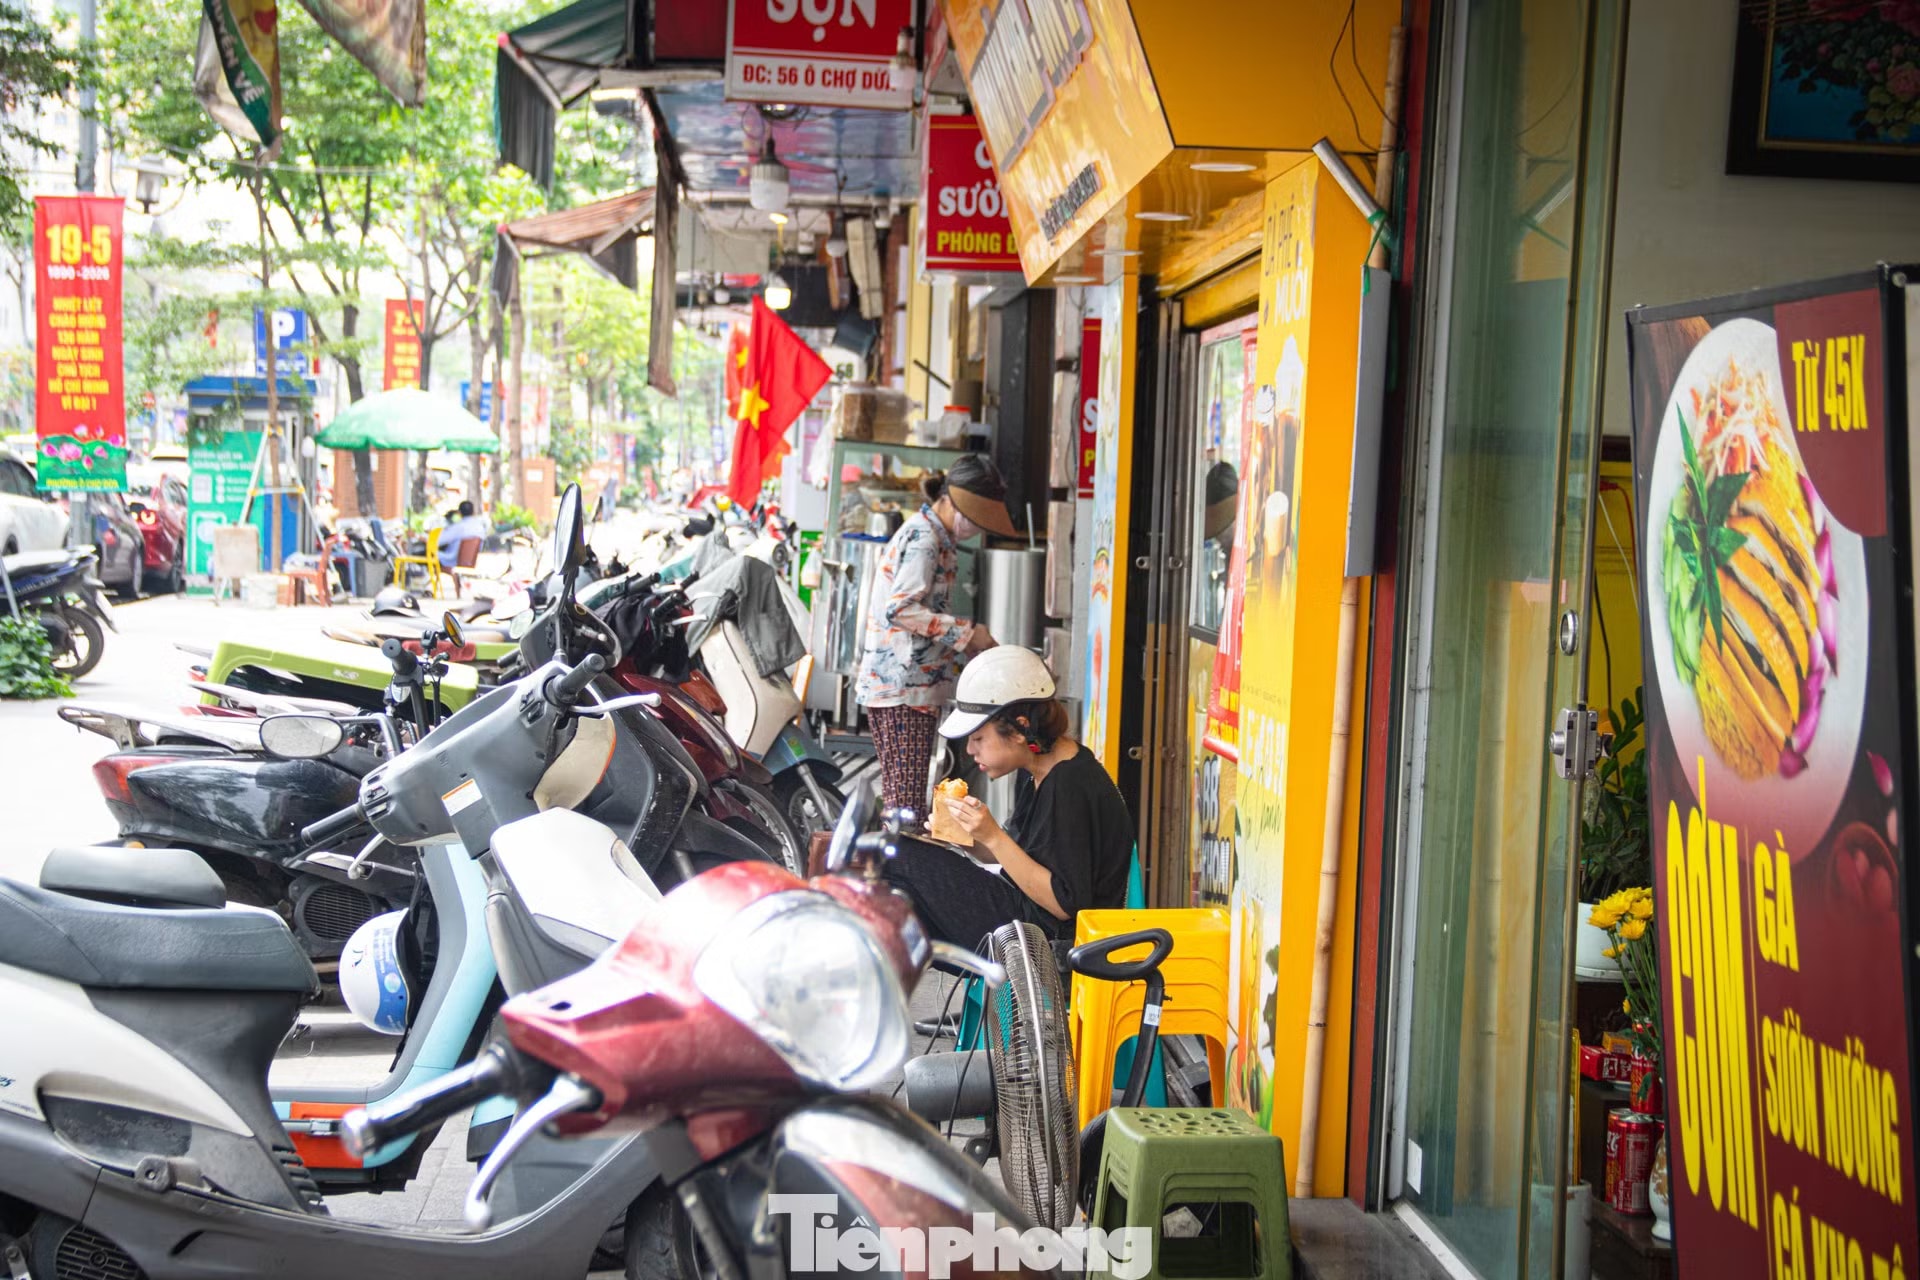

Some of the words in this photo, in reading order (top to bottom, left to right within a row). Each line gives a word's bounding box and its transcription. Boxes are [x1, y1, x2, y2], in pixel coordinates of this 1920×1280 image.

[743, 64, 772, 84] ĐC:
[777, 66, 798, 85] 56
[821, 68, 857, 93] CHỢ
[46, 223, 111, 265] 19-5
[271, 310, 296, 350] P
[1824, 333, 1868, 432] 45K
[1754, 829, 1799, 973] GÀ
[1666, 755, 1758, 1231] CƠM
[1762, 1007, 1820, 1160] SƯỜN
[1820, 1035, 1903, 1206] NƯỚNG
[1773, 1185, 1808, 1280] CÁ
